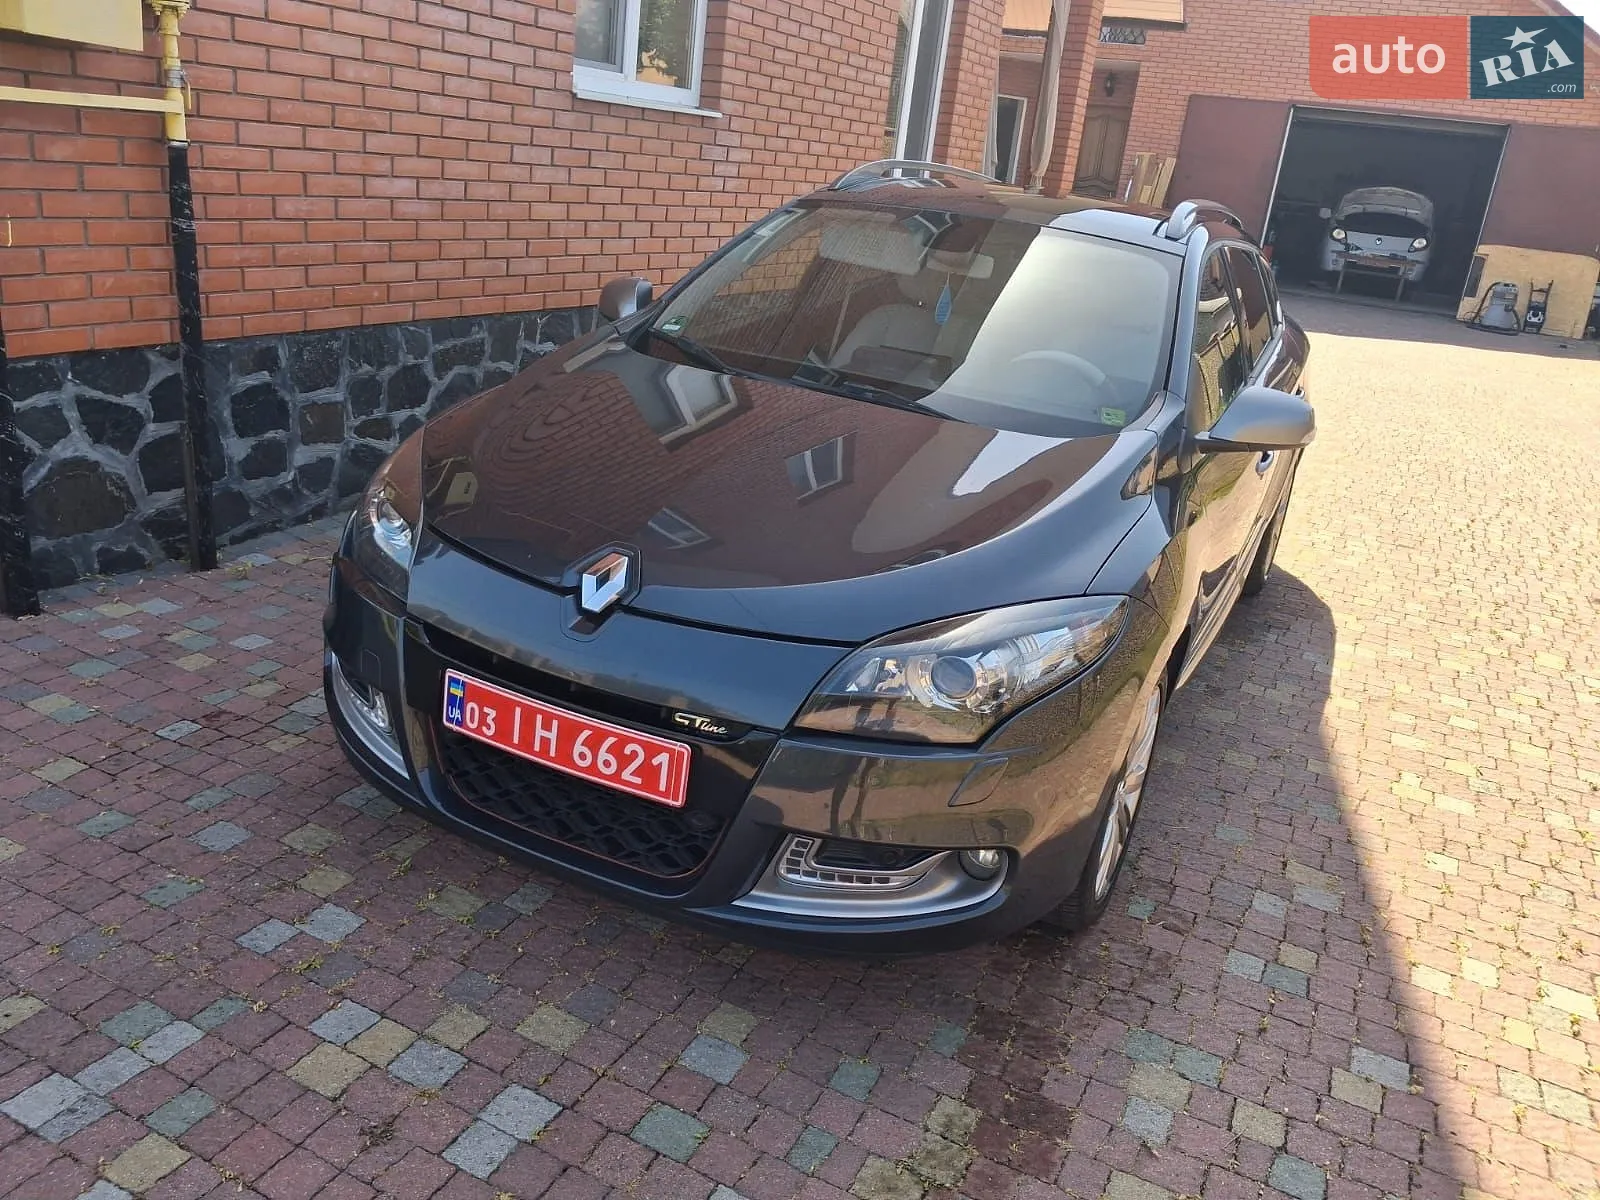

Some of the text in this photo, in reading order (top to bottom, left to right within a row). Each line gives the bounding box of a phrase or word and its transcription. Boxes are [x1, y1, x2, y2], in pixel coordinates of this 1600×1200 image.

[448, 705, 462, 722] UA
[465, 702, 497, 736] 03
[572, 729, 670, 792] 6621
